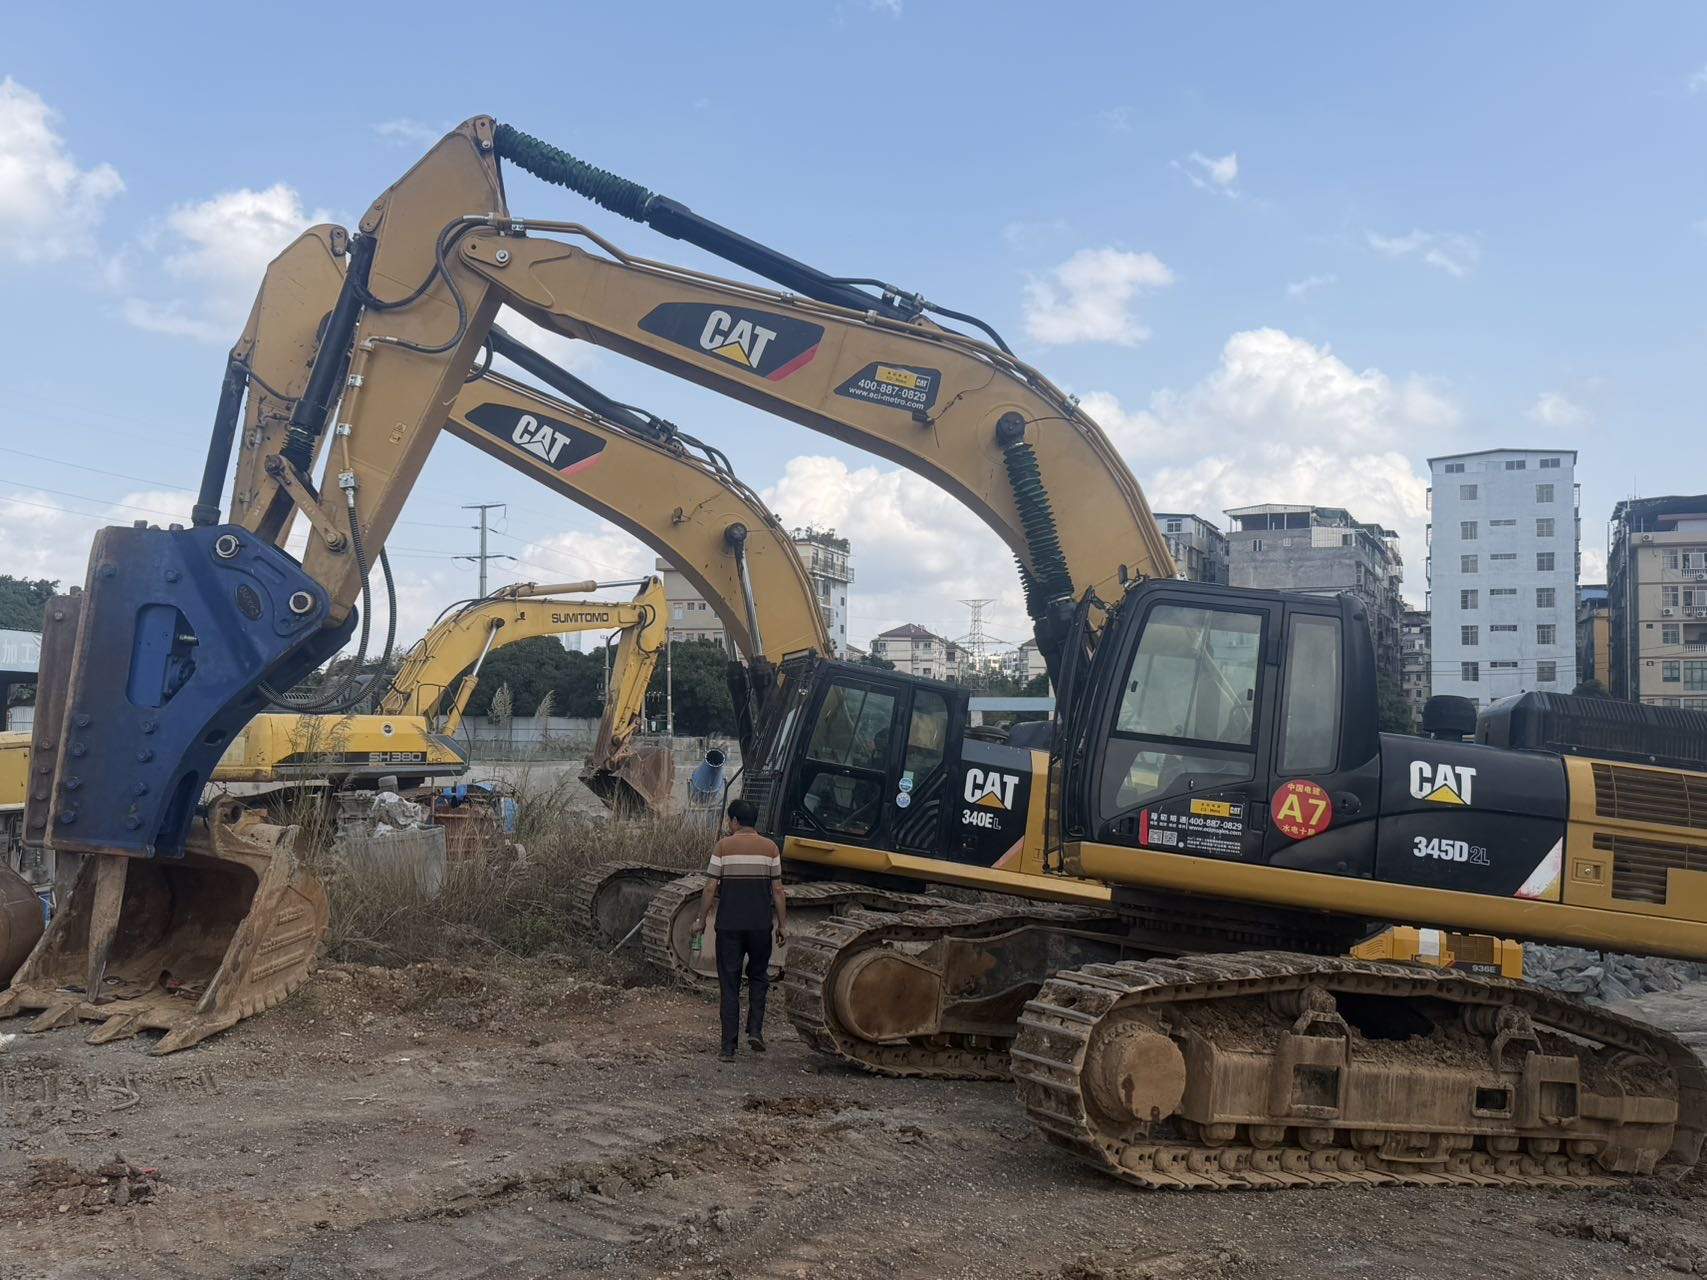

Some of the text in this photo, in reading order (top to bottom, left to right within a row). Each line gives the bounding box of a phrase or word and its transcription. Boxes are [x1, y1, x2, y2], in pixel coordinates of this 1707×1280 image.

[700, 310, 777, 369] CAT
[849, 387, 924, 410] www.eci-metro.com
[858, 378, 927, 402] 400-887-0829
[512, 414, 571, 463] CAT
[552, 612, 609, 623] SUMITOMO
[369, 752, 422, 762] SH380
[963, 768, 1020, 810] CAT
[1409, 760, 1477, 805] CAT
[1276, 793, 1327, 826] A7
[1188, 817, 1242, 831] 400-887-0829
[1472, 964, 1497, 973] 936E
